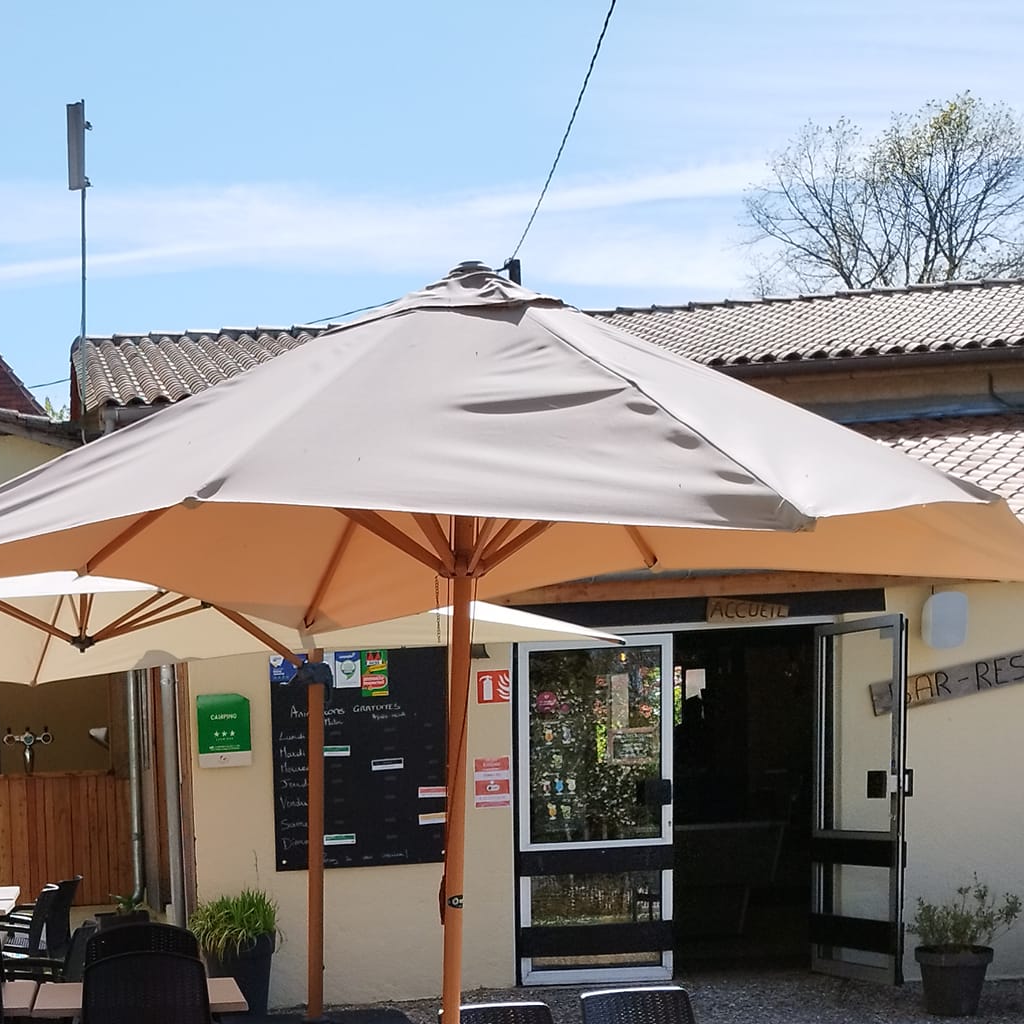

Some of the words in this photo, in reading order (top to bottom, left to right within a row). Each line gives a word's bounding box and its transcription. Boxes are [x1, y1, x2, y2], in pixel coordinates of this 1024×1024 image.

[710, 601, 786, 618] ACCUEIL
[279, 746, 306, 758] Mardi
[280, 778, 309, 789] Jeud
